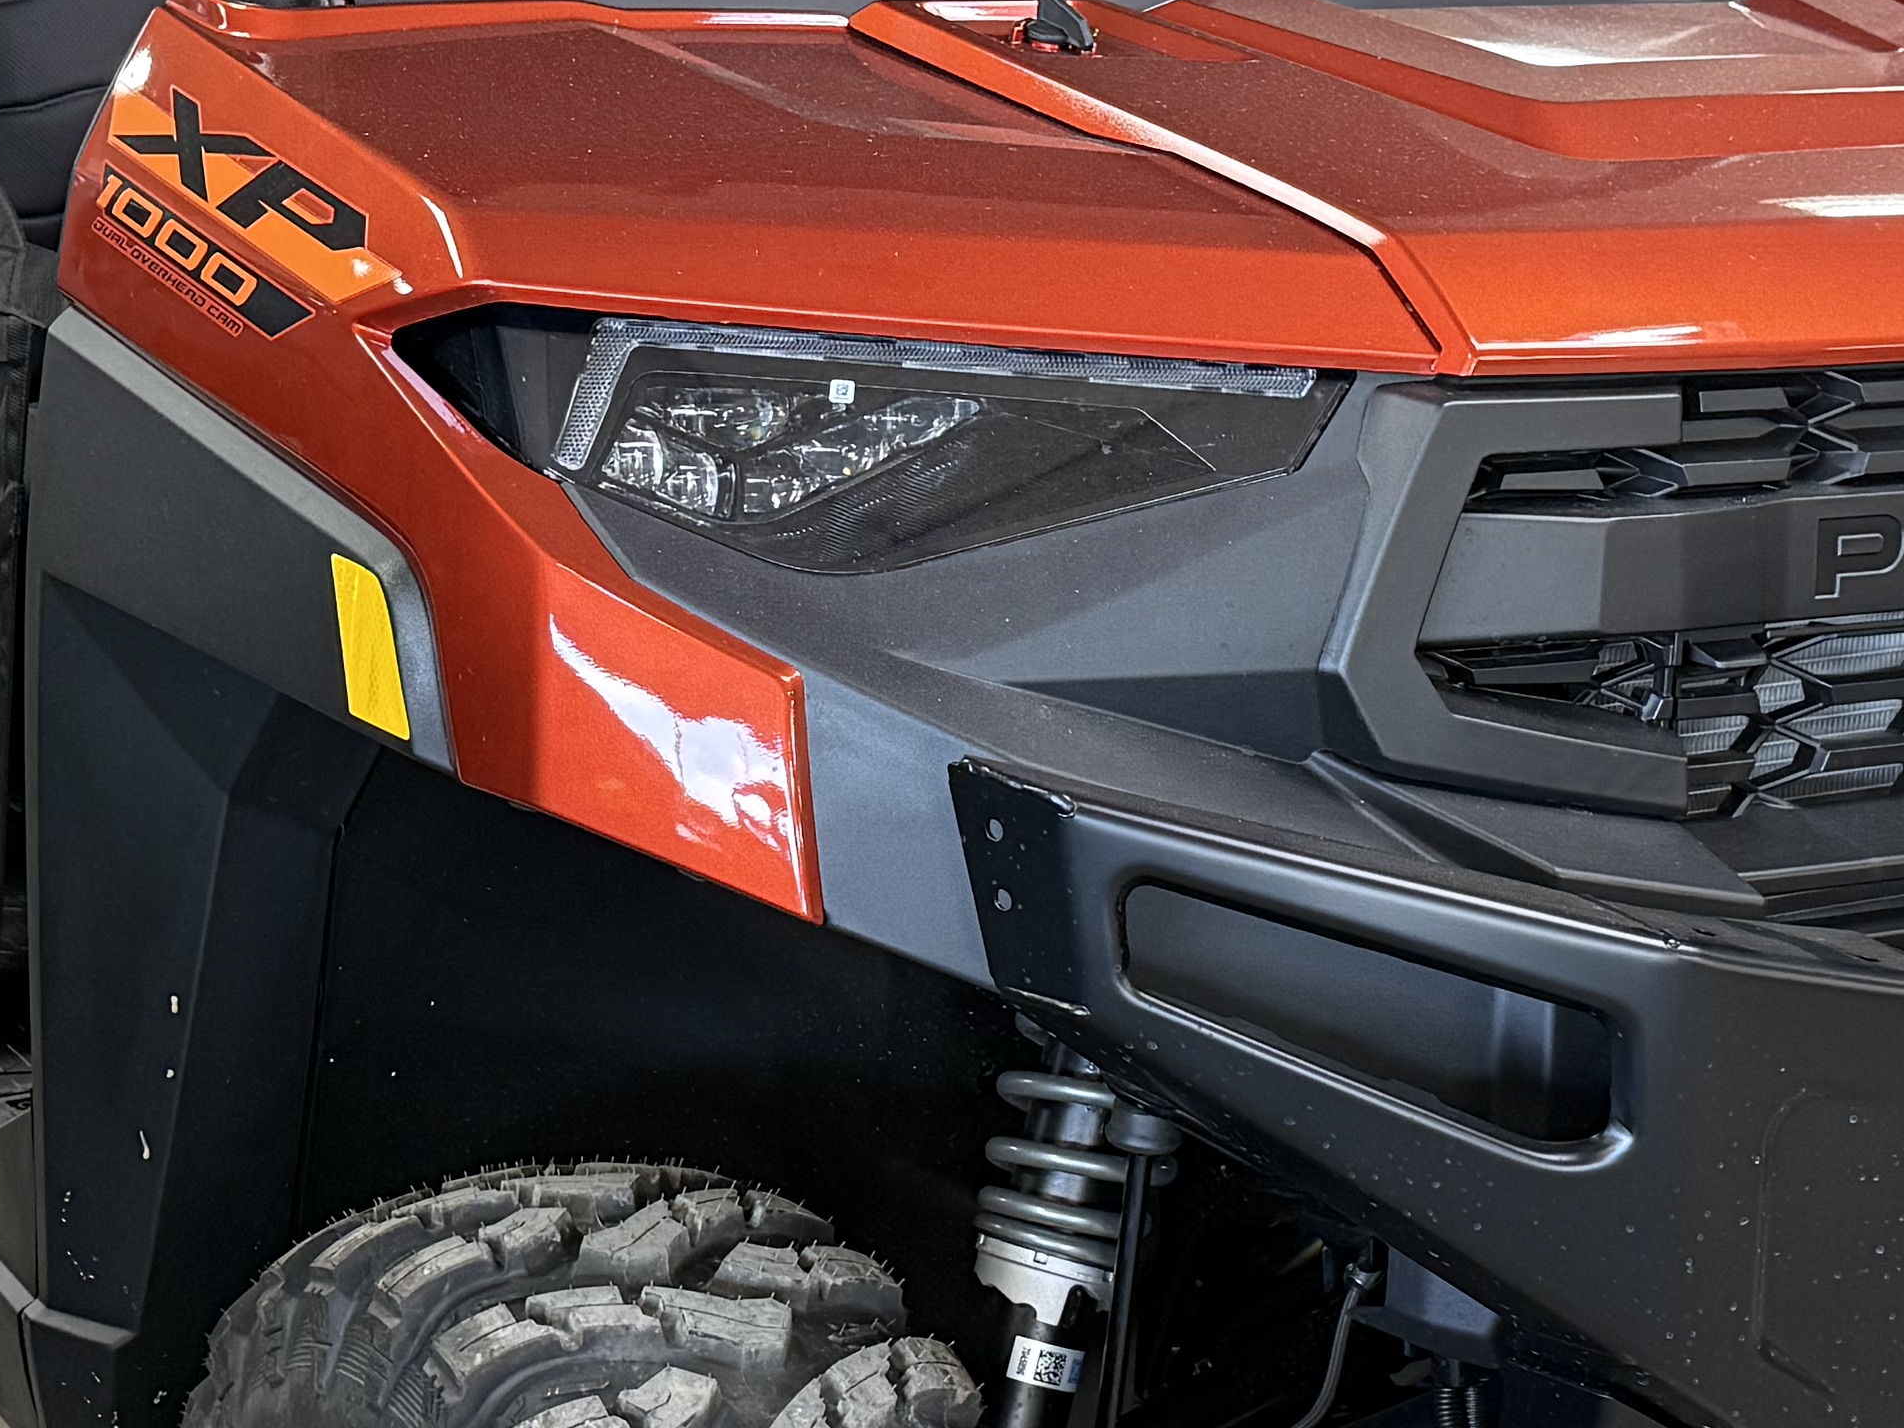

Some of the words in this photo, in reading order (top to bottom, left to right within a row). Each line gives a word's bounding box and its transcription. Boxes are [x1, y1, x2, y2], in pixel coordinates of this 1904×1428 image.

[112, 89, 369, 252] XP
[96, 174, 258, 307] 1000
[206, 304, 243, 337] CAM
